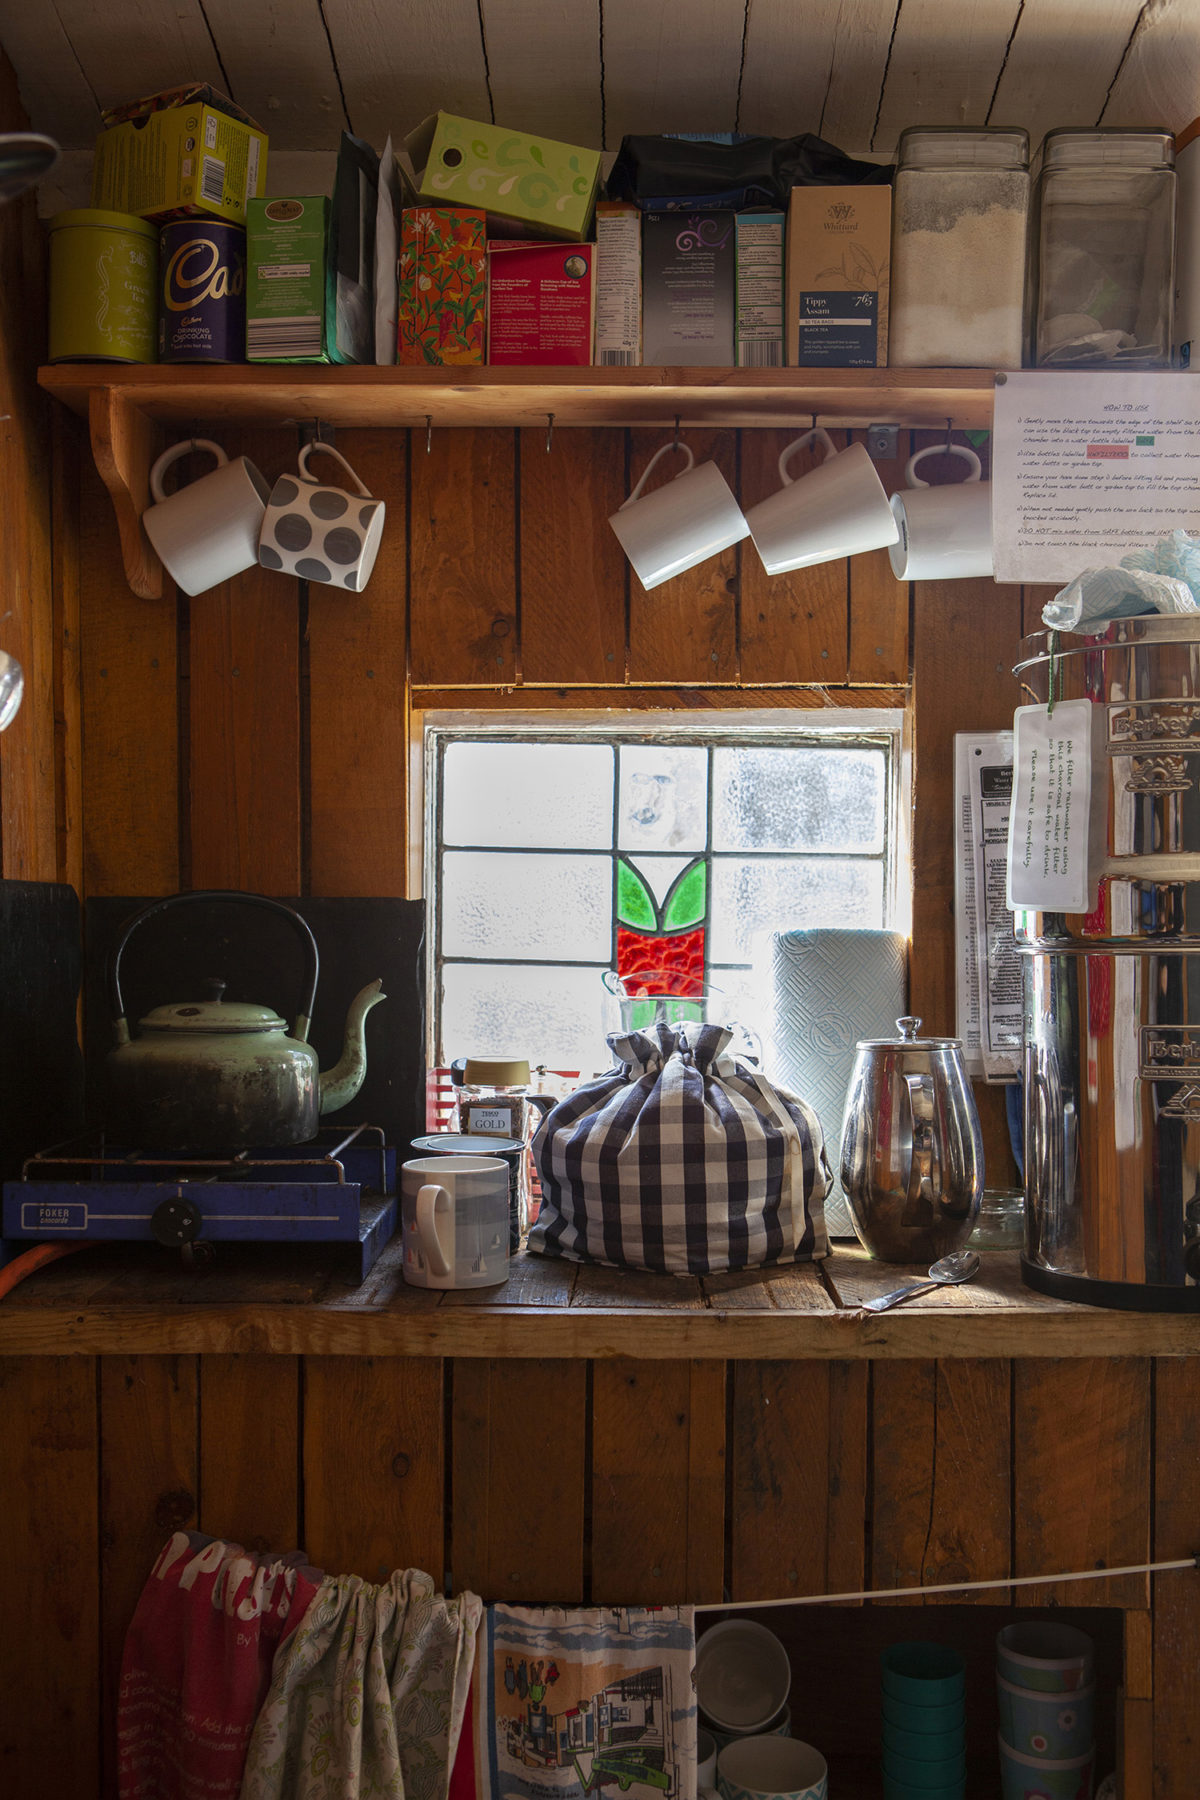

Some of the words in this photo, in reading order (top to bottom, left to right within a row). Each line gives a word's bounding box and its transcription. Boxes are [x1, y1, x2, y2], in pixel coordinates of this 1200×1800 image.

[804, 297, 827, 307] Tippy
[855, 293, 874, 307] 765
[805, 307, 830, 315] Assam
[172, 333, 212, 343] CHOCOLATE
[1048, 738, 1054, 750] so
[1066, 740, 1073, 755] We
[1066, 759, 1074, 787] filter
[1048, 778, 1055, 787] it
[1047, 791, 1054, 800] is
[1028, 807, 1034, 816] it
[1045, 804, 1053, 826] safe
[1063, 791, 1072, 842] rainwater
[1044, 830, 1052, 841] to
[1052, 846, 1061, 874] filter
[1061, 846, 1069, 875] using
[475, 1120, 506, 1129] GOLD
[40, 1208, 70, 1217] FOKER
[237, 1633, 252, 1648] By
